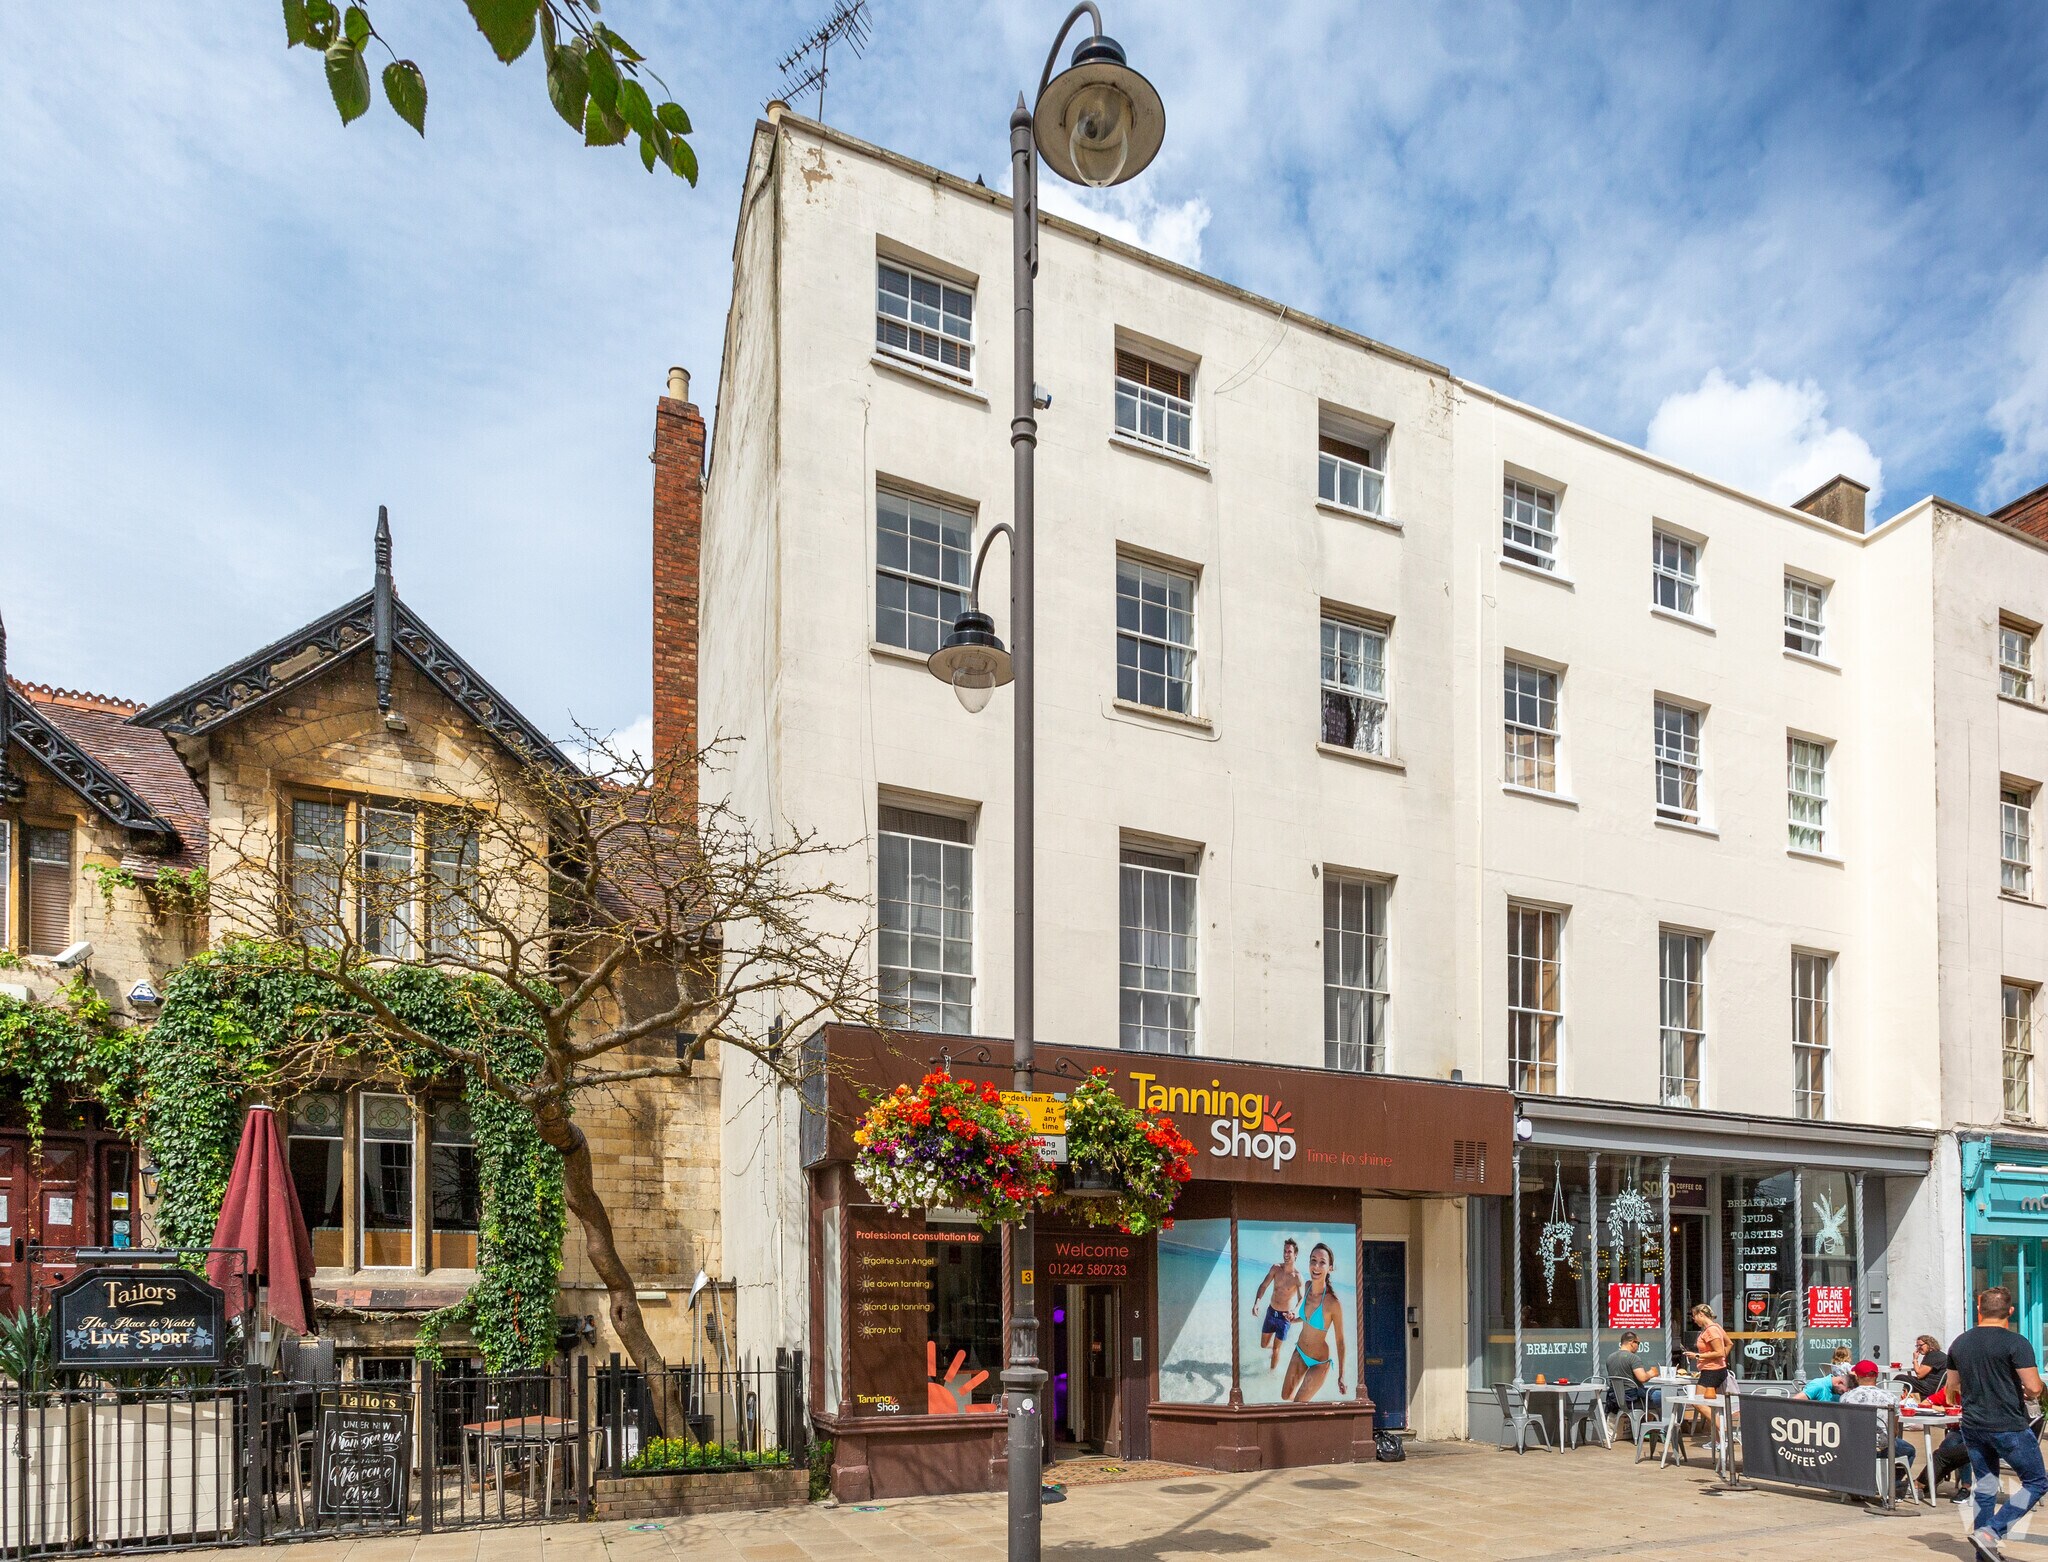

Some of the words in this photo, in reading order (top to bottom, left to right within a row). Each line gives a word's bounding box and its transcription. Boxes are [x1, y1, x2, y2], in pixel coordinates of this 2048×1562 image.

[1002, 1094, 1042, 1102] Pdestrian
[1130, 1072, 1262, 1129] Tanning
[1210, 1118, 1296, 1170] Shop
[1306, 1149, 1337, 1164] Time
[1341, 1152, 1356, 1165] to
[1359, 1152, 1393, 1168] shine
[1727, 1198, 1787, 1207] BREAKFAST
[1740, 1214, 1773, 1223] SPUDS
[856, 1231, 910, 1240] Professional
[912, 1232, 966, 1241] consultation
[968, 1233, 980, 1242] for
[1730, 1230, 1784, 1240] TOASTIES
[1055, 1243, 1129, 1258] Welcome
[1737, 1246, 1777, 1255] FRAPPS
[863, 1256, 894, 1266] Ergoline
[912, 1257, 935, 1267] Angel
[1737, 1262, 1777, 1271] COFFEE
[1048, 1264, 1083, 1275] 01242
[1086, 1264, 1127, 1276] 580733
[1025, 1272, 1032, 1282] 3
[876, 1280, 899, 1288] down
[900, 1281, 930, 1289] tanning
[103, 1281, 176, 1308] Tailors
[1620, 1287, 1632, 1298] WE
[1634, 1287, 1650, 1298] ARE
[1817, 1289, 1828, 1300] WE
[1830, 1290, 1843, 1300] ARE
[864, 1303, 887, 1311] Stand
[888, 1304, 899, 1313] up
[901, 1303, 930, 1312] tanning
[1619, 1298, 1650, 1313] OPEN!
[1817, 1300, 1843, 1313] OPEN!
[1134, 1310, 1140, 1319] 3
[78, 1316, 107, 1330] The
[110, 1317, 146, 1330] Place
[148, 1319, 159, 1328] to
[160, 1317, 196, 1329] Watch
[864, 1326, 886, 1335] Spray
[888, 1326, 901, 1334] tan
[91, 1330, 129, 1345] LIVE
[139, 1330, 190, 1344] SPORT
[1526, 1342, 1588, 1355] BREAKFAST
[857, 1394, 890, 1404] Tanning
[877, 1402, 900, 1413] Shop
[1771, 1416, 1840, 1448] SOHO
[1778, 1446, 1816, 1467] COFFEE
[1818, 1452, 1838, 1465] CO.
